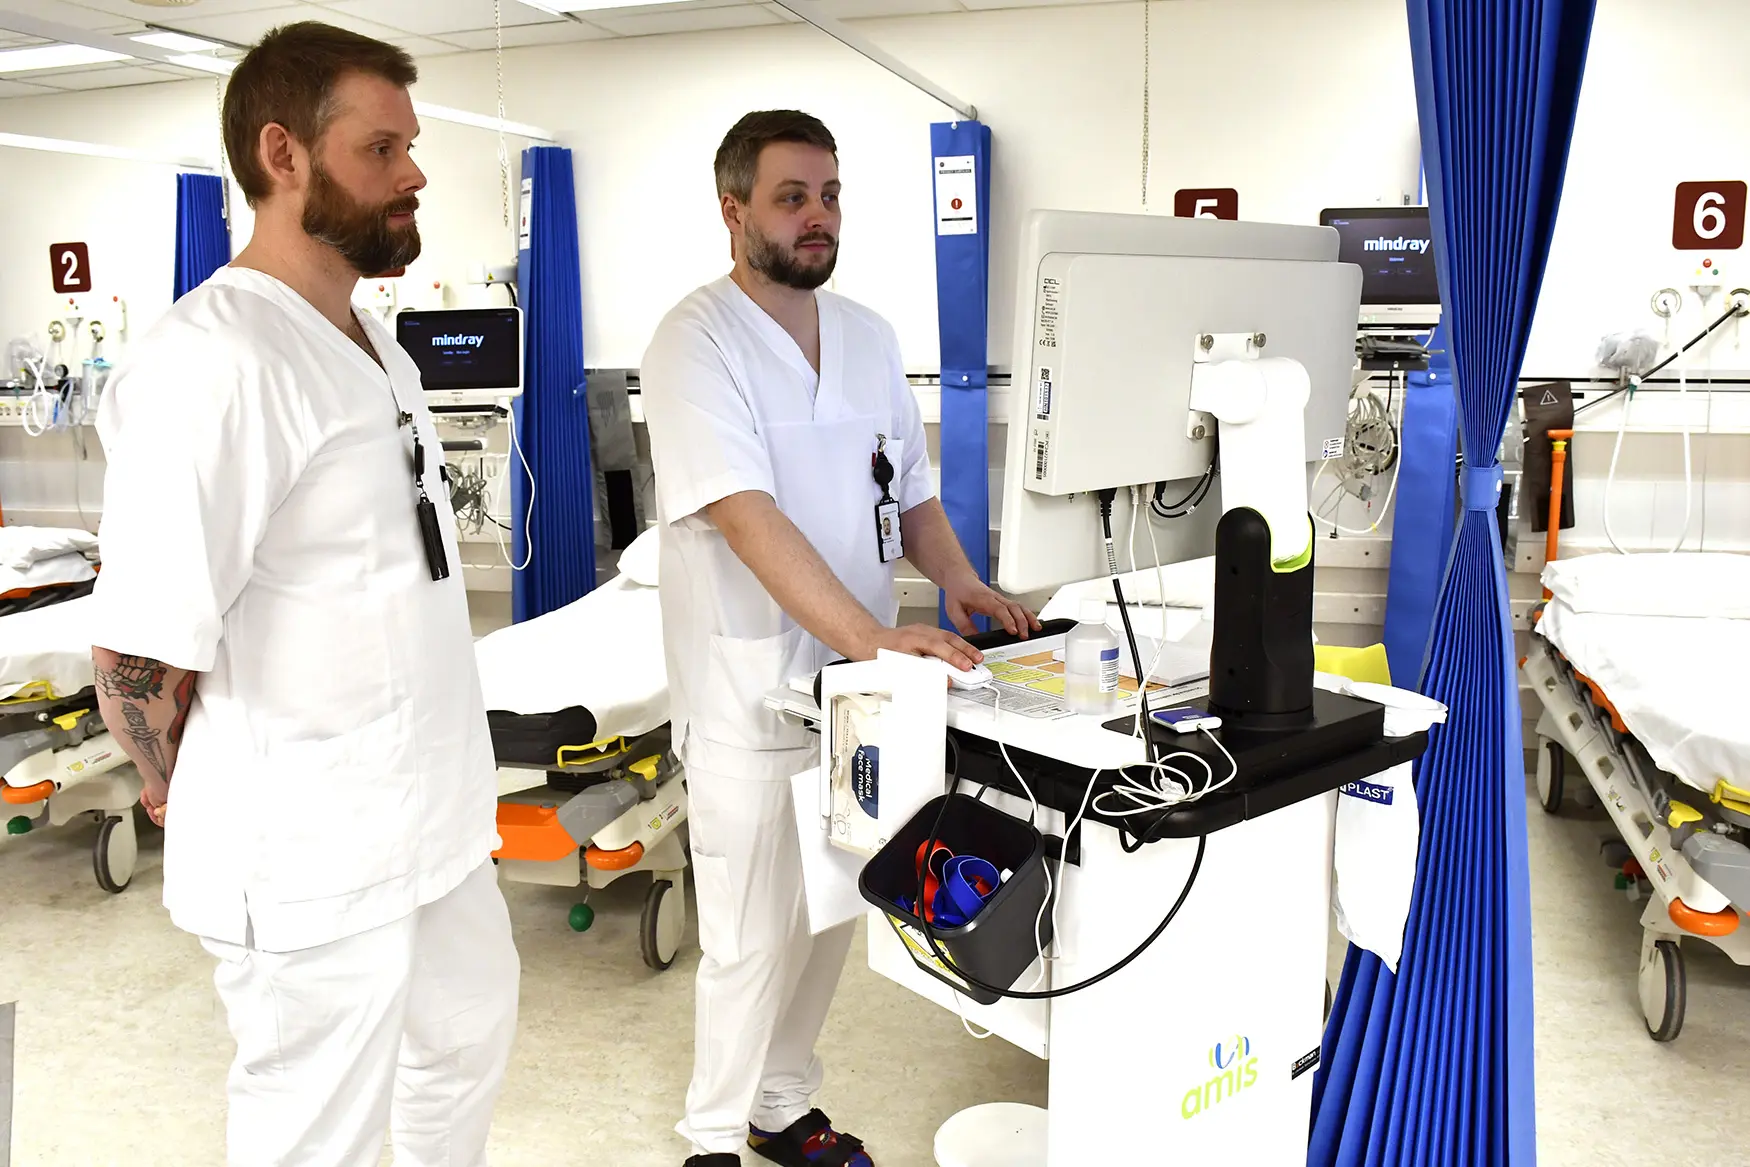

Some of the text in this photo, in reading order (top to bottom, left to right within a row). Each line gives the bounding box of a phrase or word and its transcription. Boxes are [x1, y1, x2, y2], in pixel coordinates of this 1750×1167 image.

[1194, 198, 1219, 219] 5
[1693, 191, 1726, 240] 6
[1363, 236, 1430, 255] mindray
[61, 250, 80, 286] 2
[432, 333, 484, 348] mindray
[865, 758, 873, 798] Medical
[1181, 1056, 1259, 1120] amis
